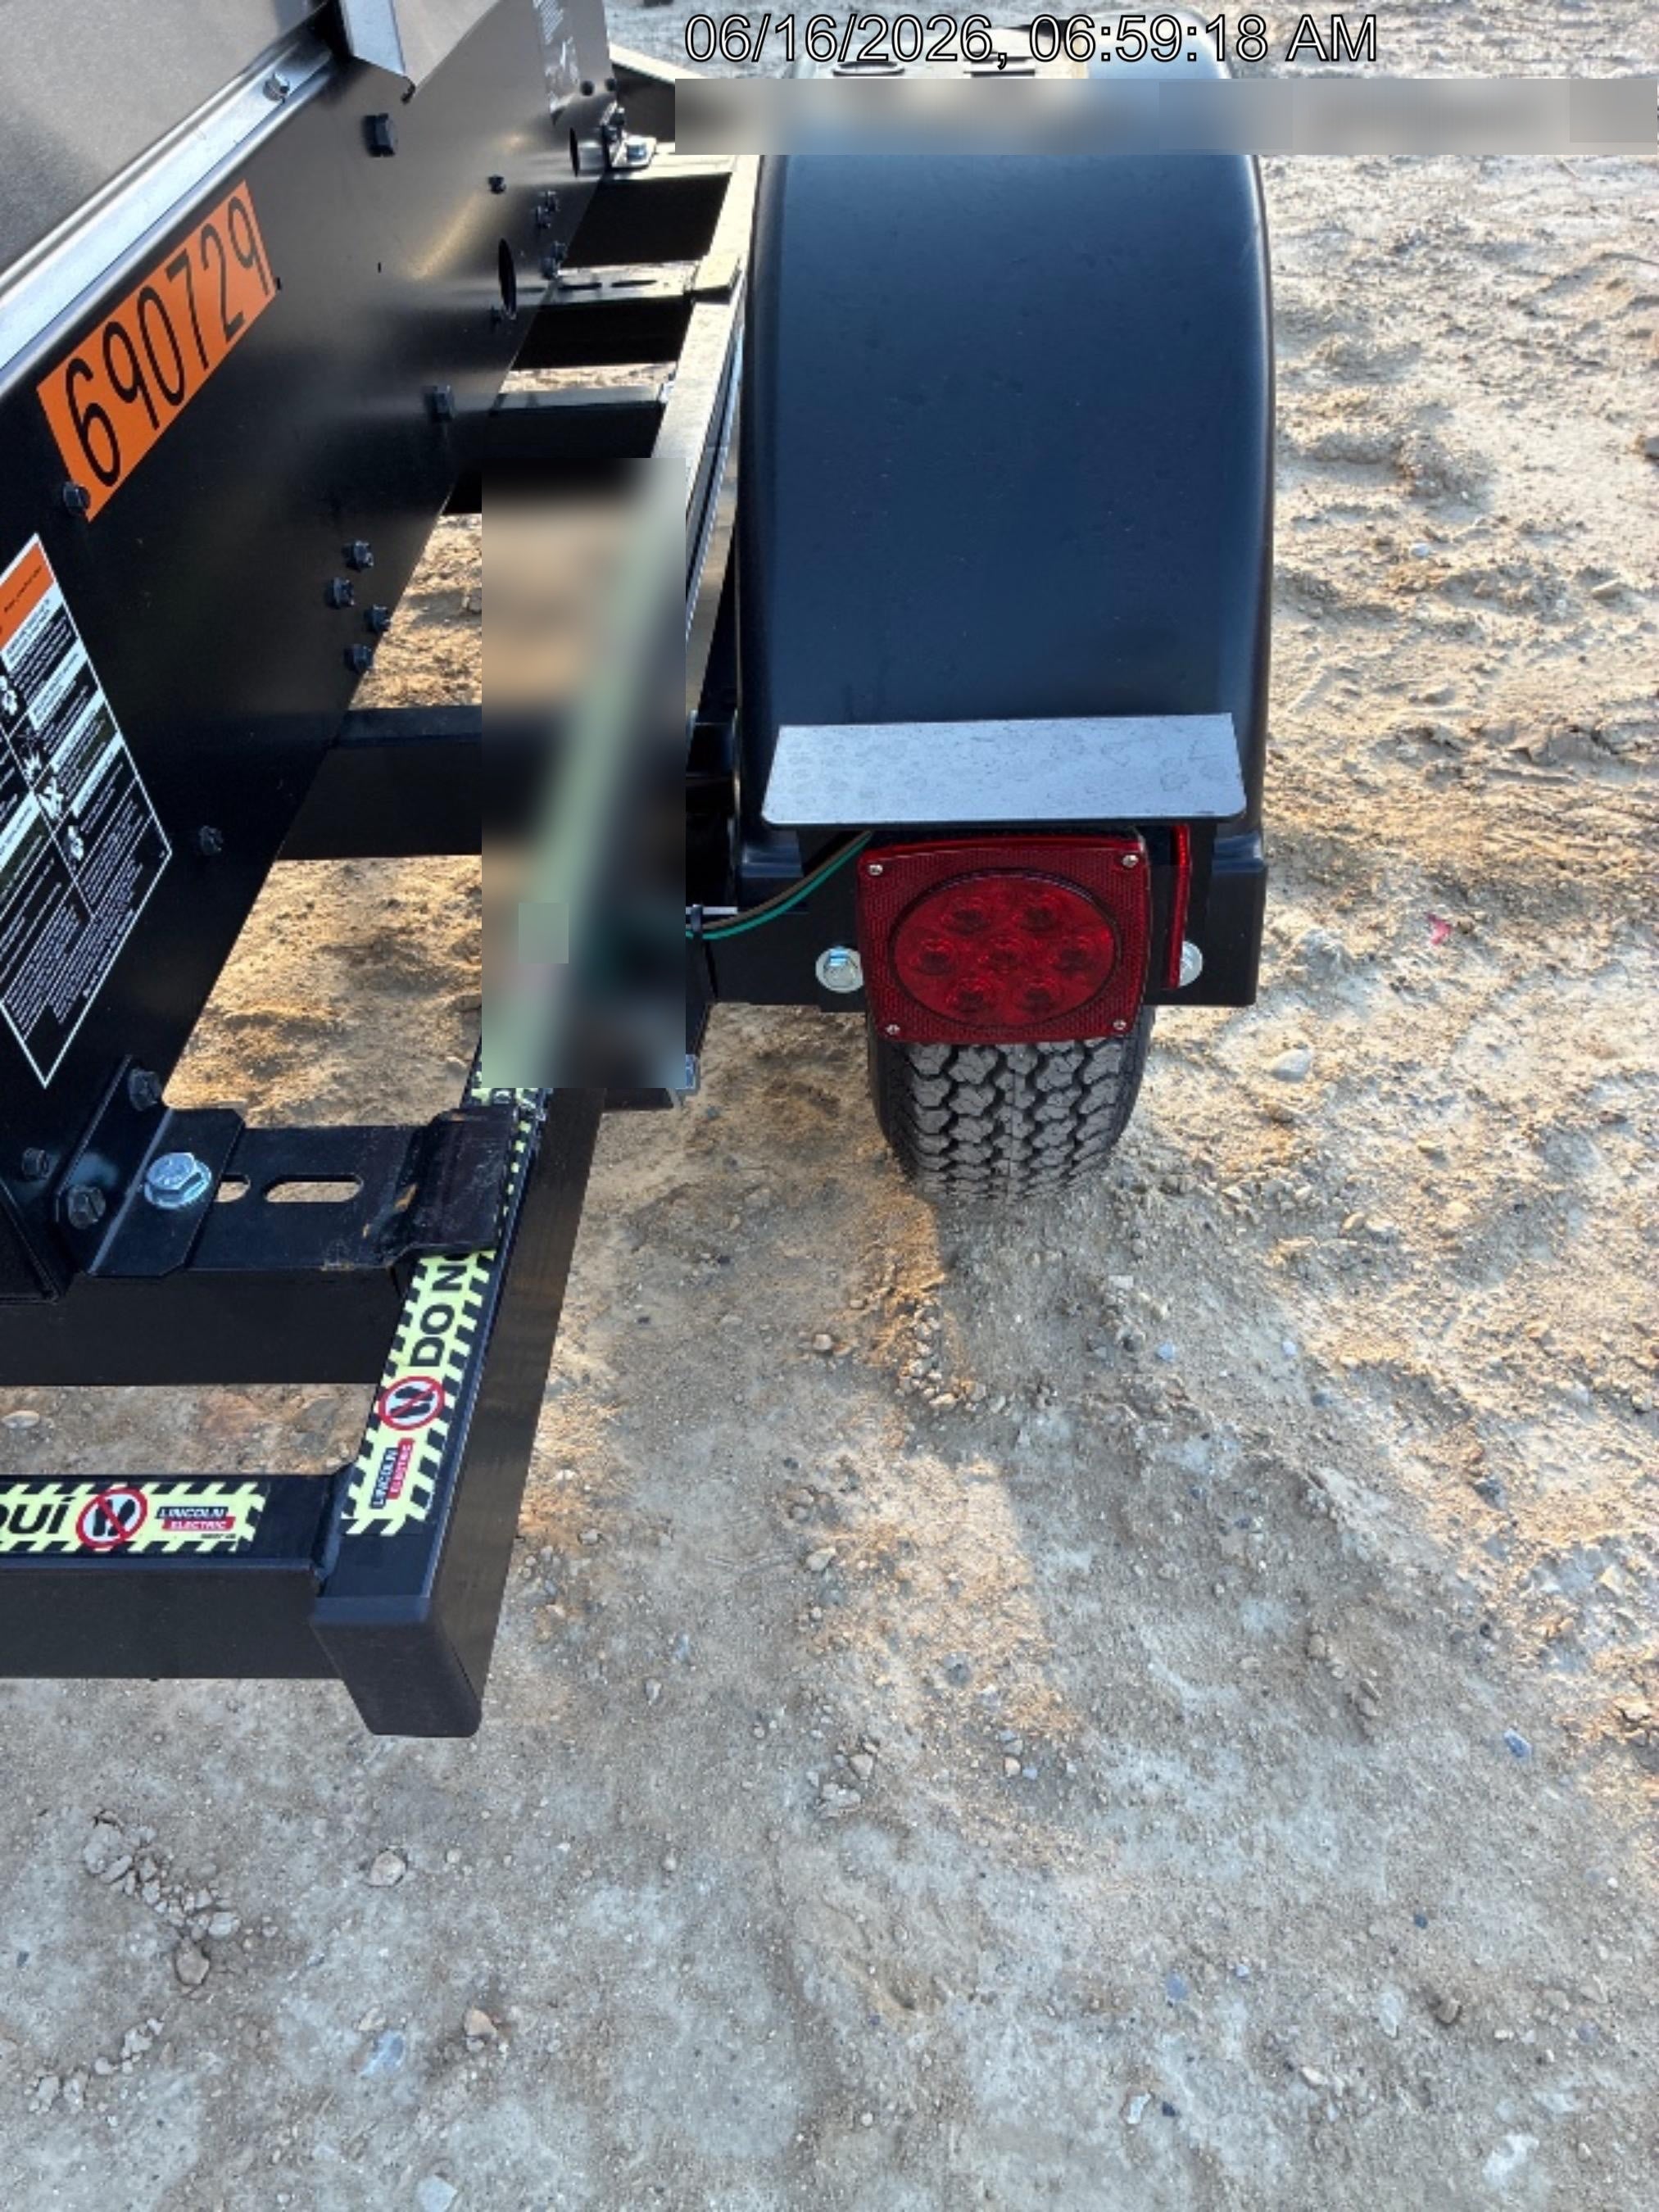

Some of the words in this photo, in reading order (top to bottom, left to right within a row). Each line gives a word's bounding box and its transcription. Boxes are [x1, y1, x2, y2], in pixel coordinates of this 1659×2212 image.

[65, 196, 270, 487] 690729
[371, 1448, 398, 1507] LINCOLN
[158, 1507, 226, 1518] LINCOLN
[168, 1520, 229, 1530] ELECTRIC
